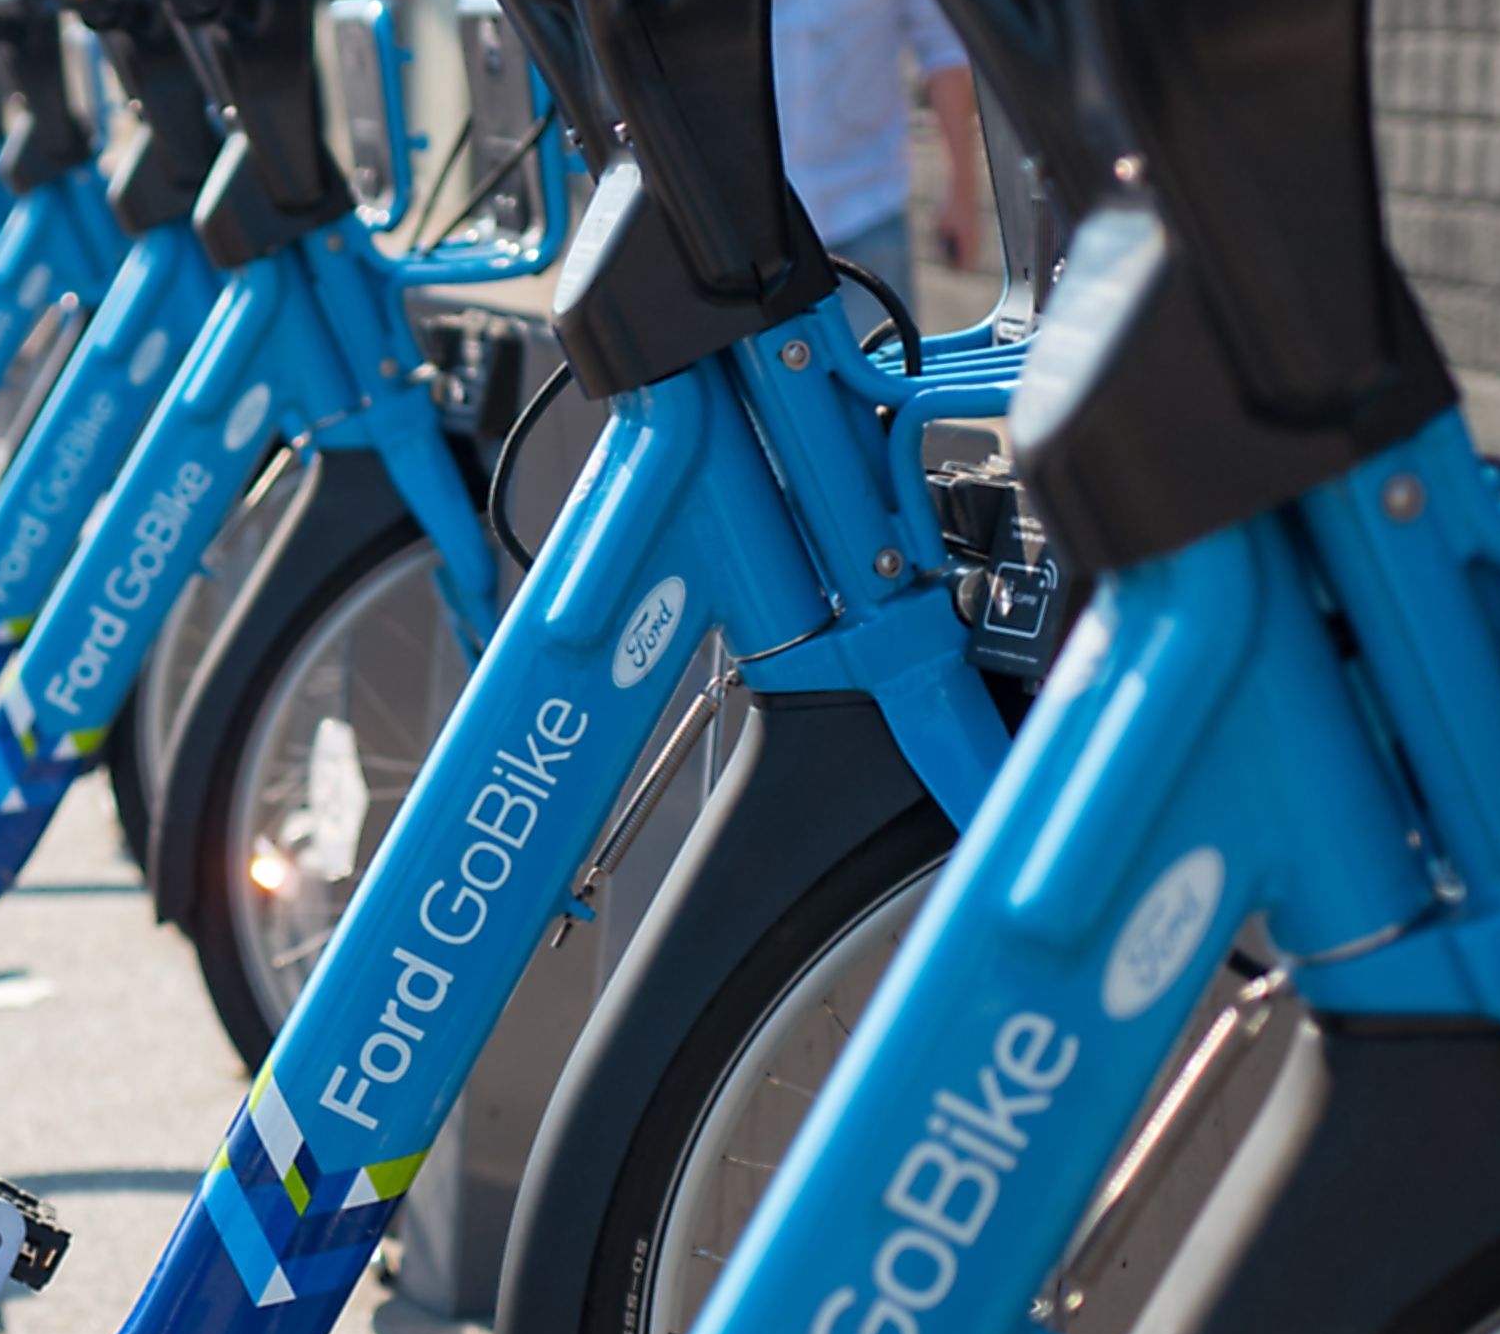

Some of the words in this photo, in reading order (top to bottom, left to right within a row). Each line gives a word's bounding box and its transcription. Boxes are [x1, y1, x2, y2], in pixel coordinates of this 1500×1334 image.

[44, 605, 128, 715] Ford
[104, 459, 213, 610] GoBike
[318, 946, 456, 1131] Ford
[419, 696, 590, 946] GoBike
